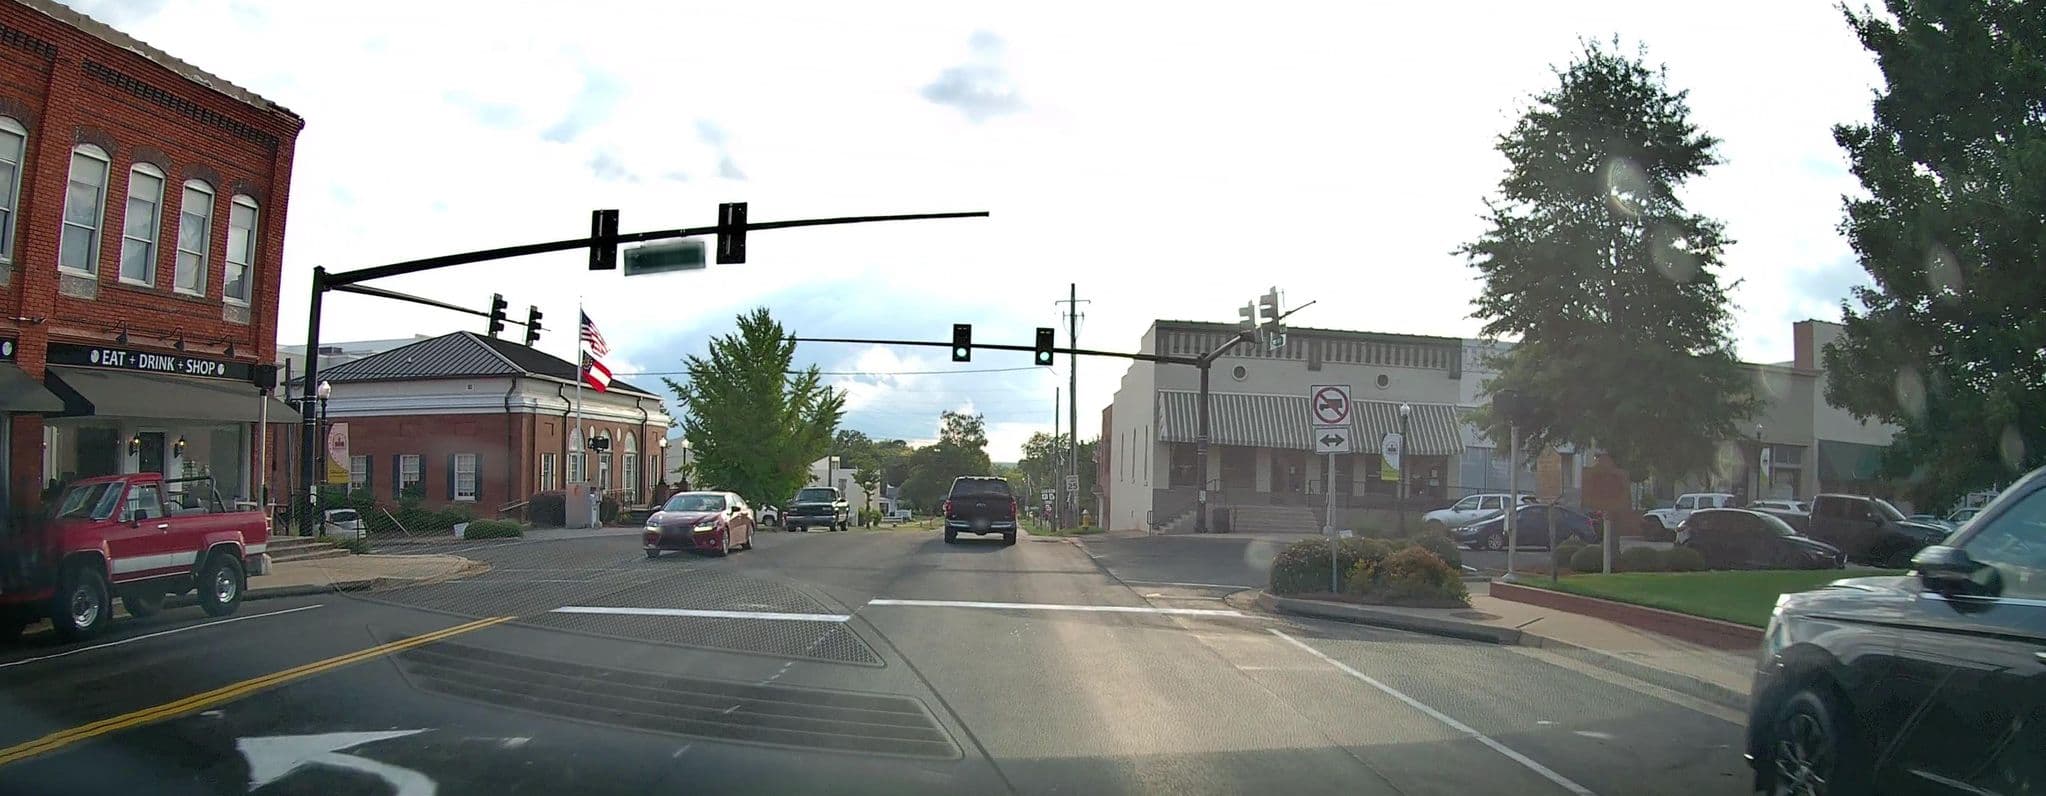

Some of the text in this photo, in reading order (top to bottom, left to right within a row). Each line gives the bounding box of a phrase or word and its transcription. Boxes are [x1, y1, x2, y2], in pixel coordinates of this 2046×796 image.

[102, 350, 126, 366] EAT
[139, 353, 175, 371] DRINK
[186, 359, 216, 375] SHOP
[1067, 481, 1077, 490] 25
